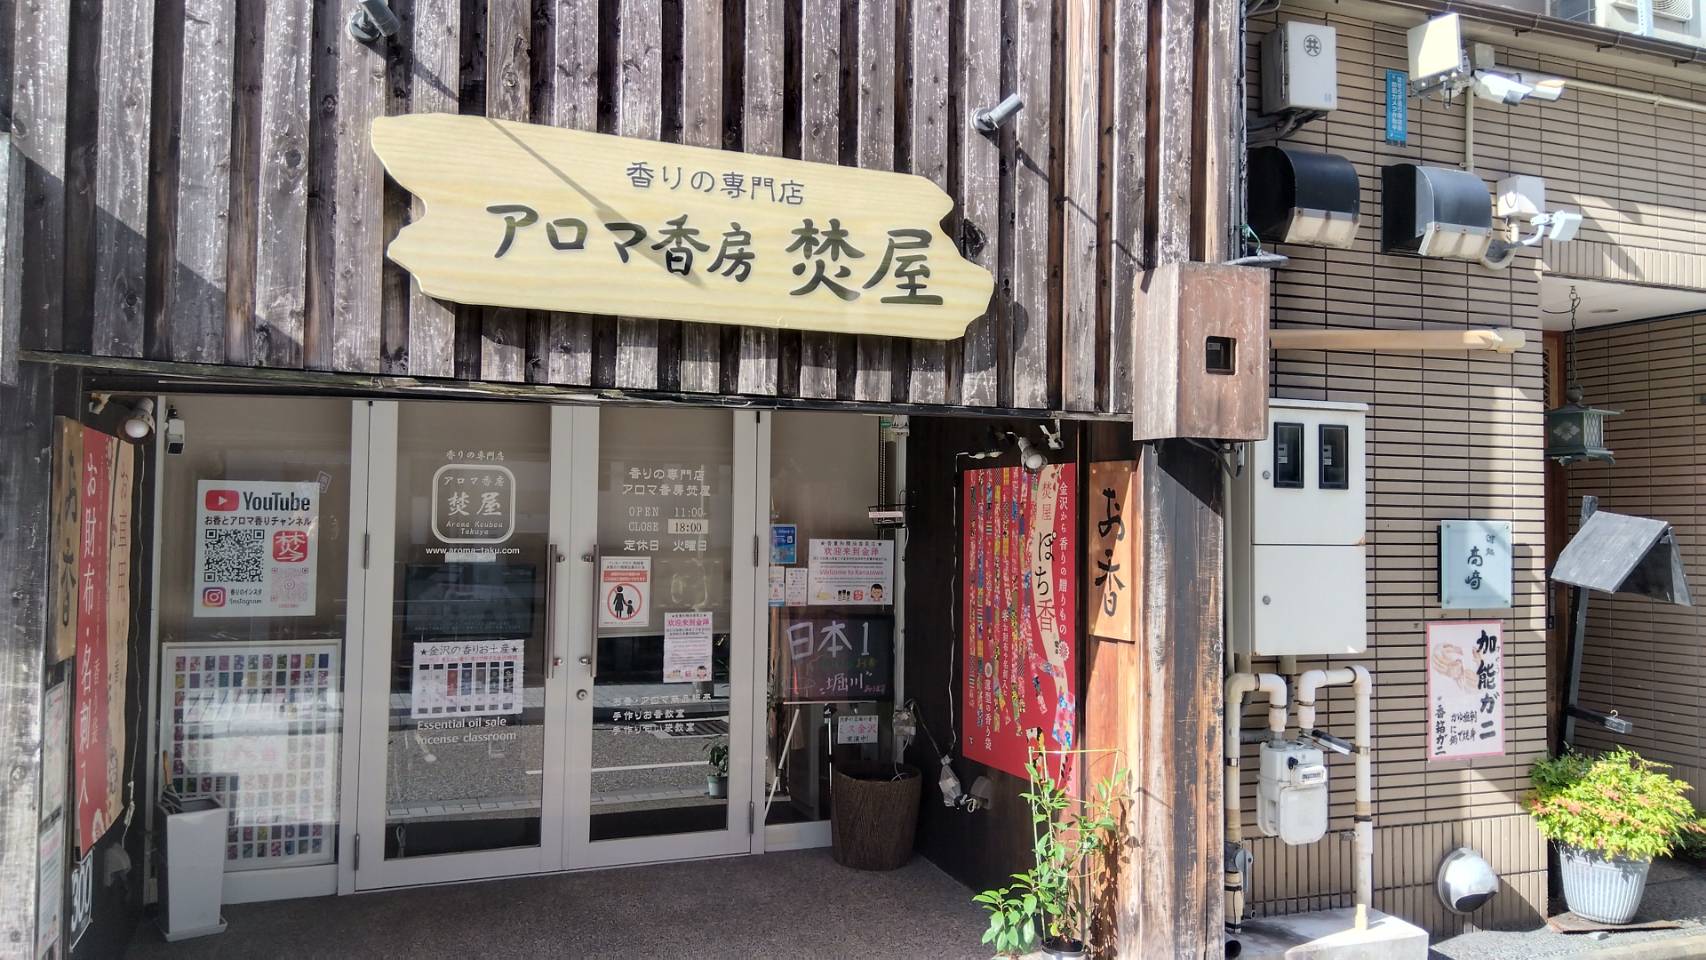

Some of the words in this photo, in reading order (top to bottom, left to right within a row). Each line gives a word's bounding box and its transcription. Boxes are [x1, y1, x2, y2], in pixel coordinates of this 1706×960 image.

[626, 161, 805, 206] 香りの専門店
[485, 204, 756, 283] アロマ香房
[785, 219, 944, 306] 焚屋
[446, 450, 505, 461] 香りの専門店
[629, 467, 705, 481] 香りの専門店
[443, 475, 505, 487] アロマ香房
[621, 484, 711, 497] アロマ香房焚屋
[243, 491, 311, 512] YouTube
[447, 491, 502, 517] 焚屋
[628, 506, 659, 517] OPEN
[674, 507, 704, 518] 11:00
[204, 515, 312, 527] お香とアロマ香りチャンネル
[628, 521, 659, 532] CLOSE
[674, 522, 702, 533] 18:00
[425, 546, 520, 555] www.aroma-taku.com
[623, 540, 659, 551] 定休日
[672, 540, 707, 552] 火曜日
[1094, 487, 1126, 617] お香
[1476, 630, 1500, 740] 加能ガニ
[612, 709, 685, 721] 手作りお香教室
[417, 719, 465, 731] Essential
[468, 717, 482, 728] oil
[485, 716, 507, 726] sale
[463, 732, 516, 742] classroom
